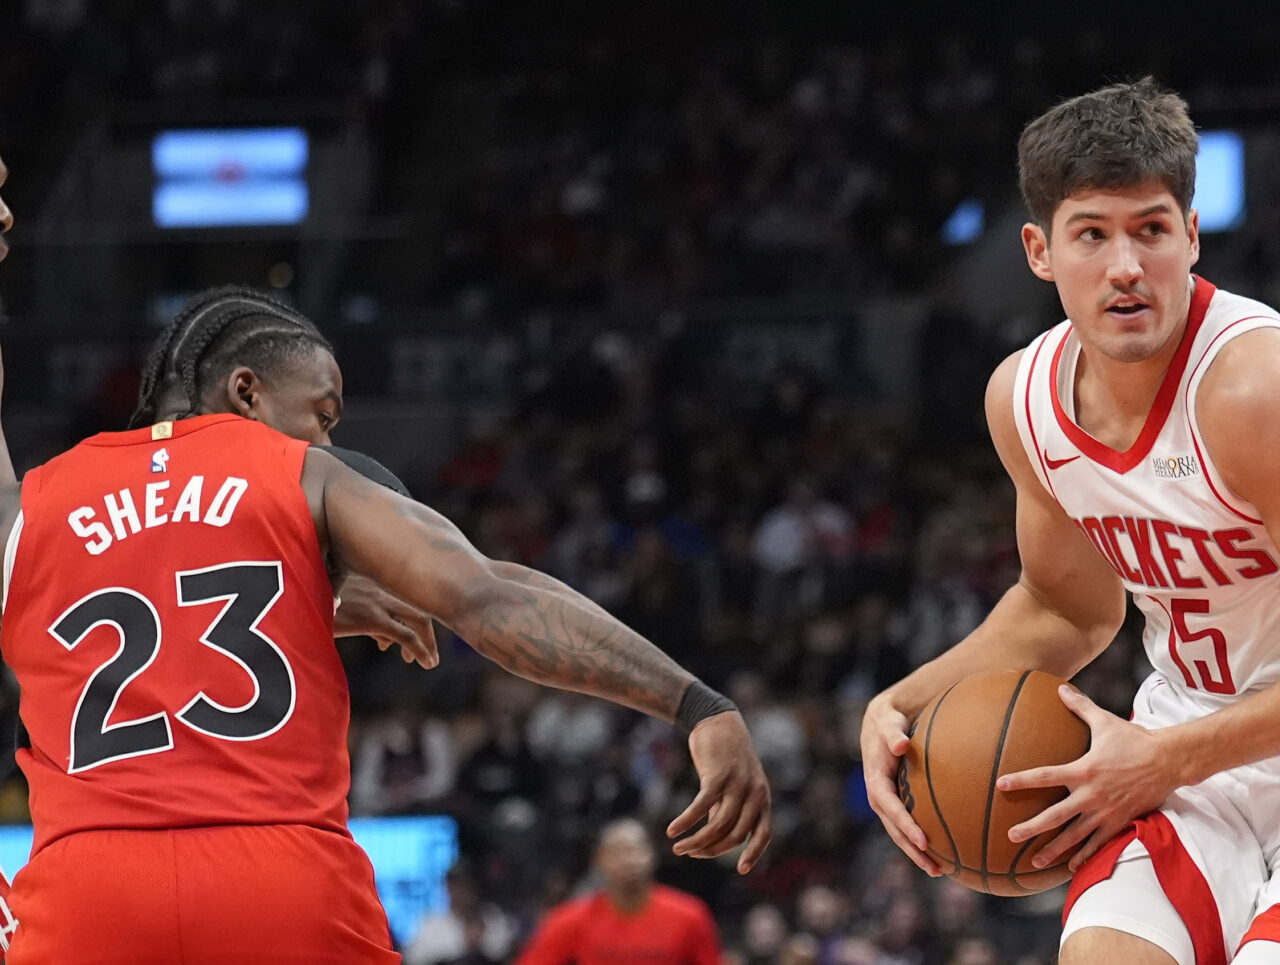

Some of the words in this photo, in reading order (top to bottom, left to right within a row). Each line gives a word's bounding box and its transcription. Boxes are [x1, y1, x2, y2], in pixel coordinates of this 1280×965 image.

[1152, 455, 1199, 470] MEMORIA
[67, 475, 248, 555] SHEAD
[1073, 515, 1280, 588] OCKETS
[47, 561, 296, 774] 23
